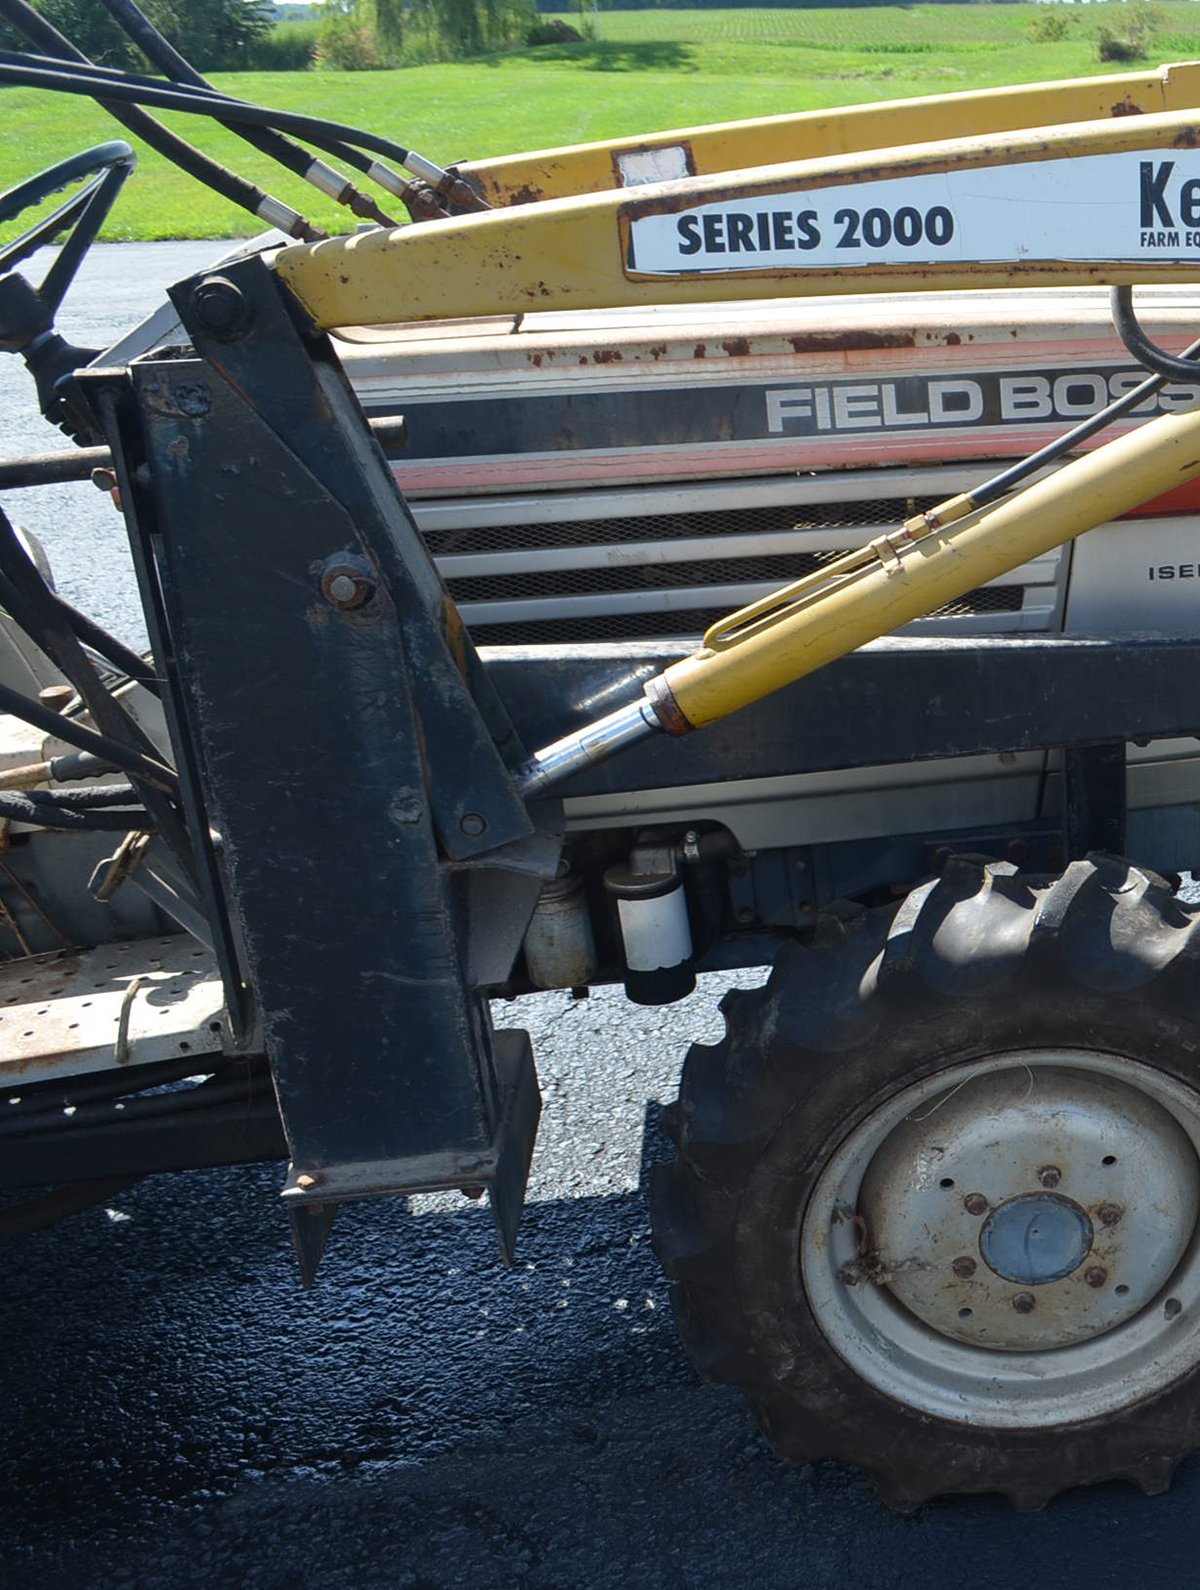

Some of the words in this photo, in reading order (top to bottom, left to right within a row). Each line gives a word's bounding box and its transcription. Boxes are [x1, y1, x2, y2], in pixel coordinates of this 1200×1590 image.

[677, 210, 821, 255] SERIES
[834, 206, 954, 248] 2000
[1140, 232, 1180, 247] FARM
[766, 380, 984, 433] FIELD
